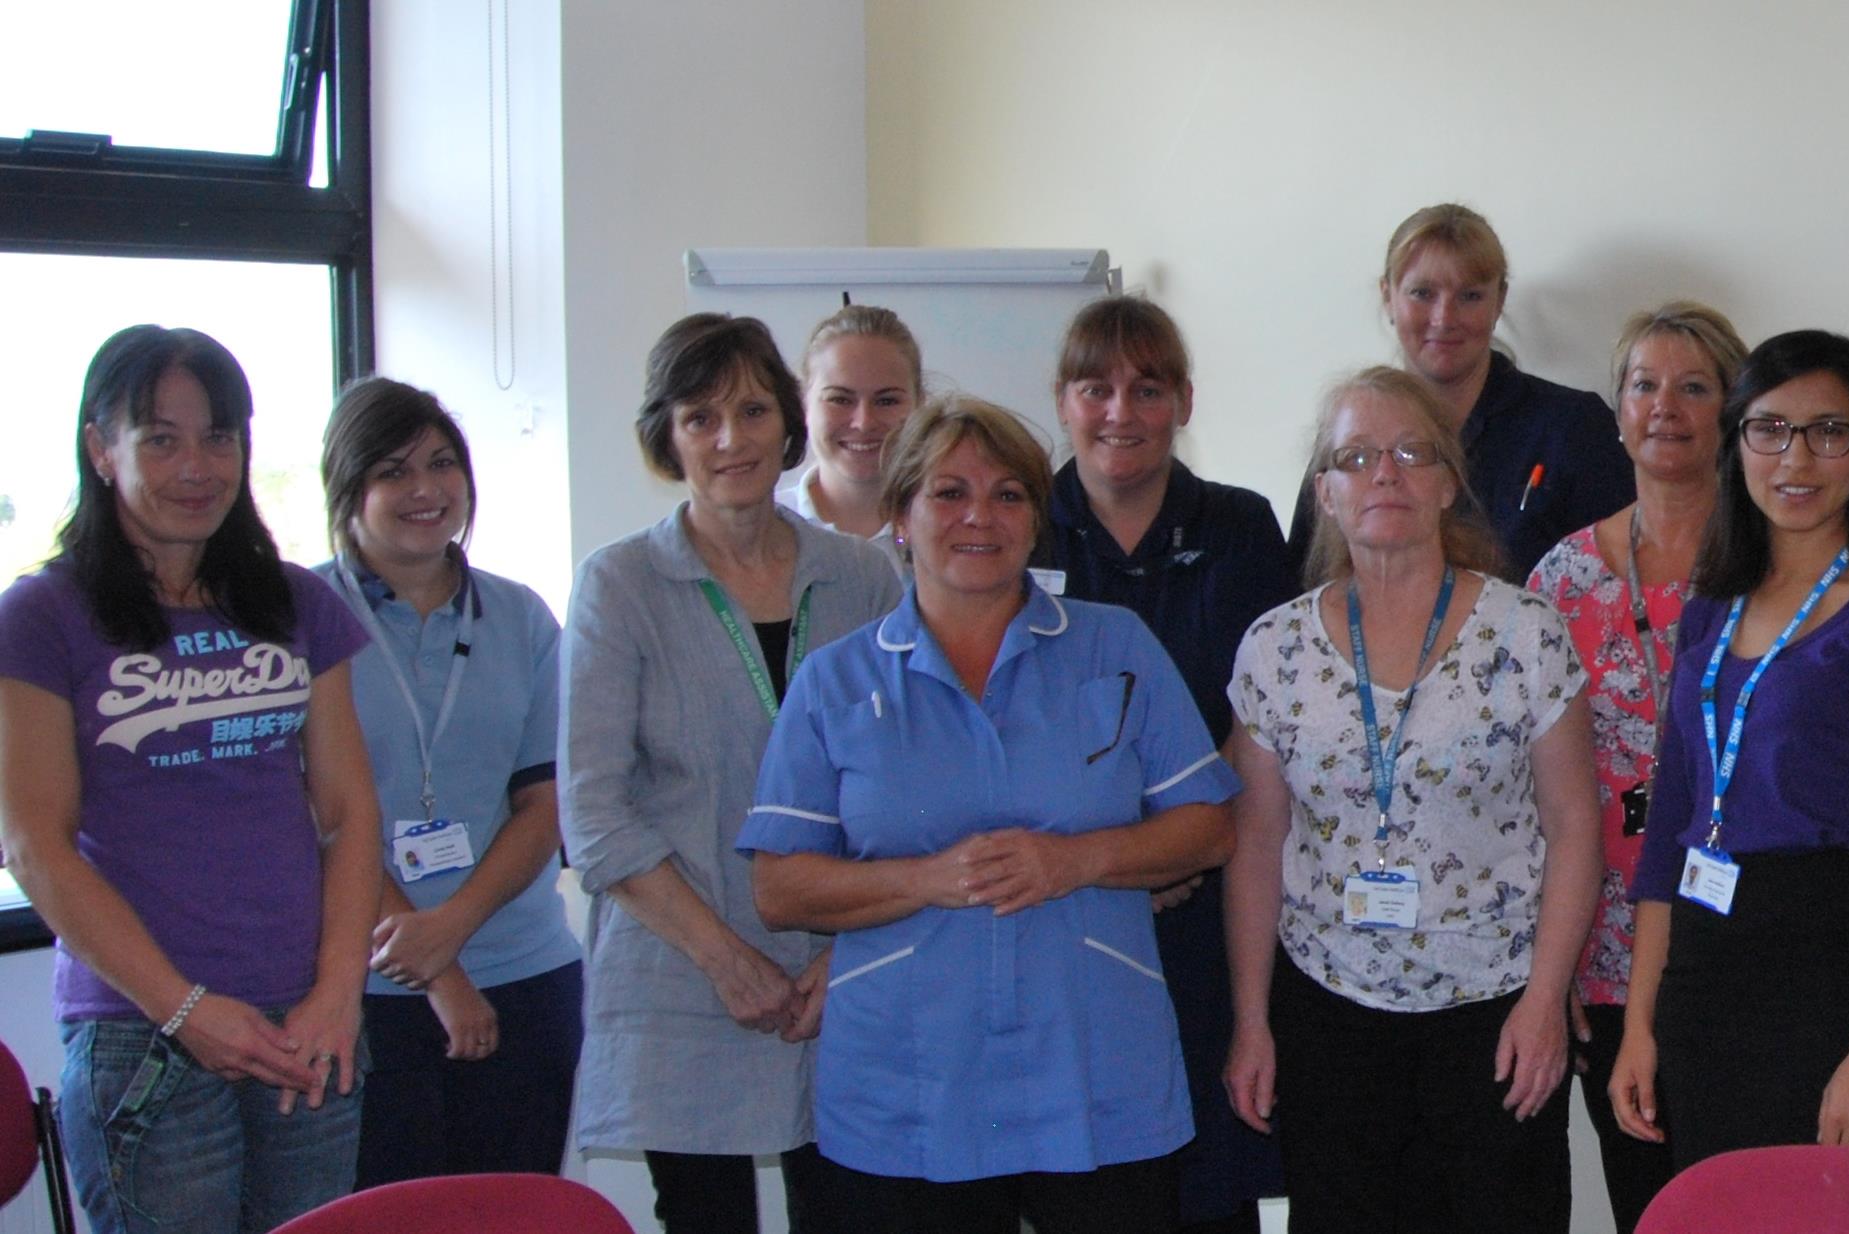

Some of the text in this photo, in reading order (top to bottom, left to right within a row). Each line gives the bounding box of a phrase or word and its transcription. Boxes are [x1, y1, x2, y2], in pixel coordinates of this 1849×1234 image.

[1820, 565, 1840, 588] NHS
[1801, 592, 1820, 613] NHS
[719, 610, 757, 674] HEALTHCARE
[1781, 619, 1800, 640] NHS
[174, 630, 249, 656] REAL
[1366, 724, 1380, 753] STAFF
[1703, 713, 1716, 740] NHS
[1729, 718, 1742, 746] NHS
[149, 749, 205, 767] TRADE.
[212, 743, 258, 760] MARK.
[1720, 751, 1735, 779] NHS
